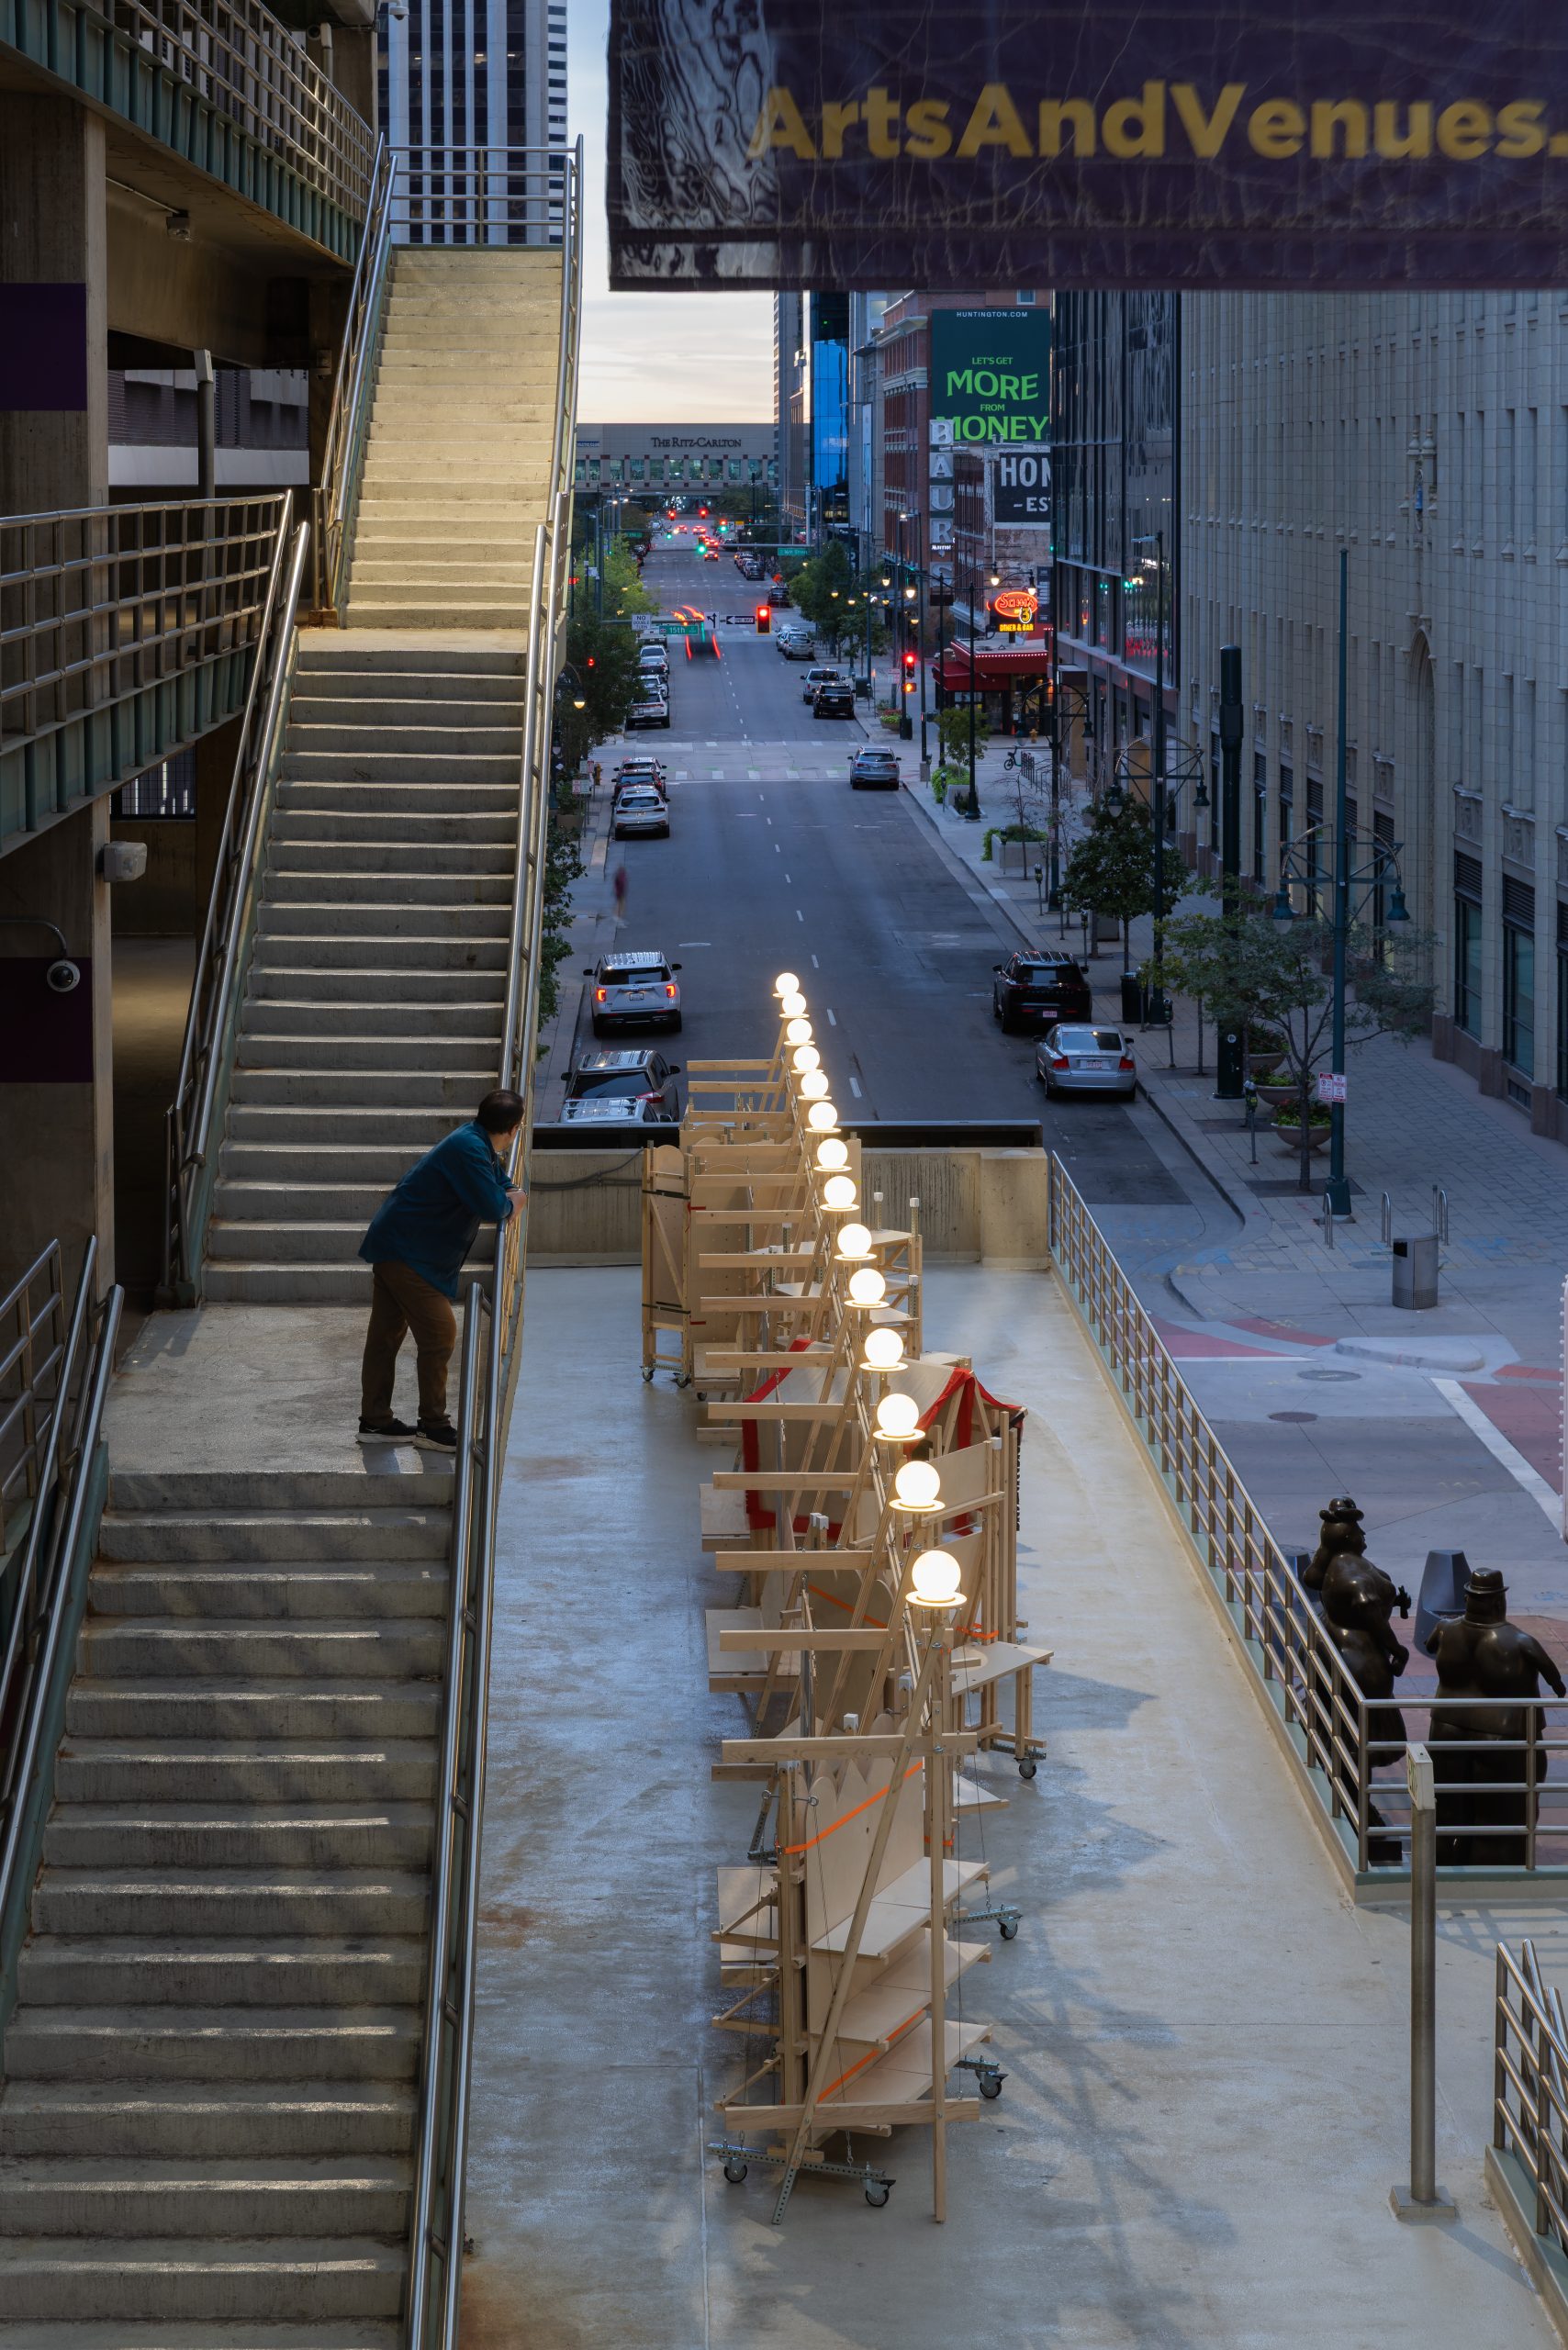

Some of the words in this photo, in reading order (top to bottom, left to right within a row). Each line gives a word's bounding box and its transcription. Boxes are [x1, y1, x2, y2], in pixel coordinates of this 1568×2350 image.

[971, 356, 995, 365] LET'S
[995, 356, 1014, 365] GET
[946, 369, 1039, 401] MORE
[980, 404, 1005, 412] FROM
[650, 437, 671, 447] THE
[672, 437, 742, 448] RITZ-CARLTON
[999, 592, 1035, 609] Sam's
[669, 626, 686, 634] 15th
